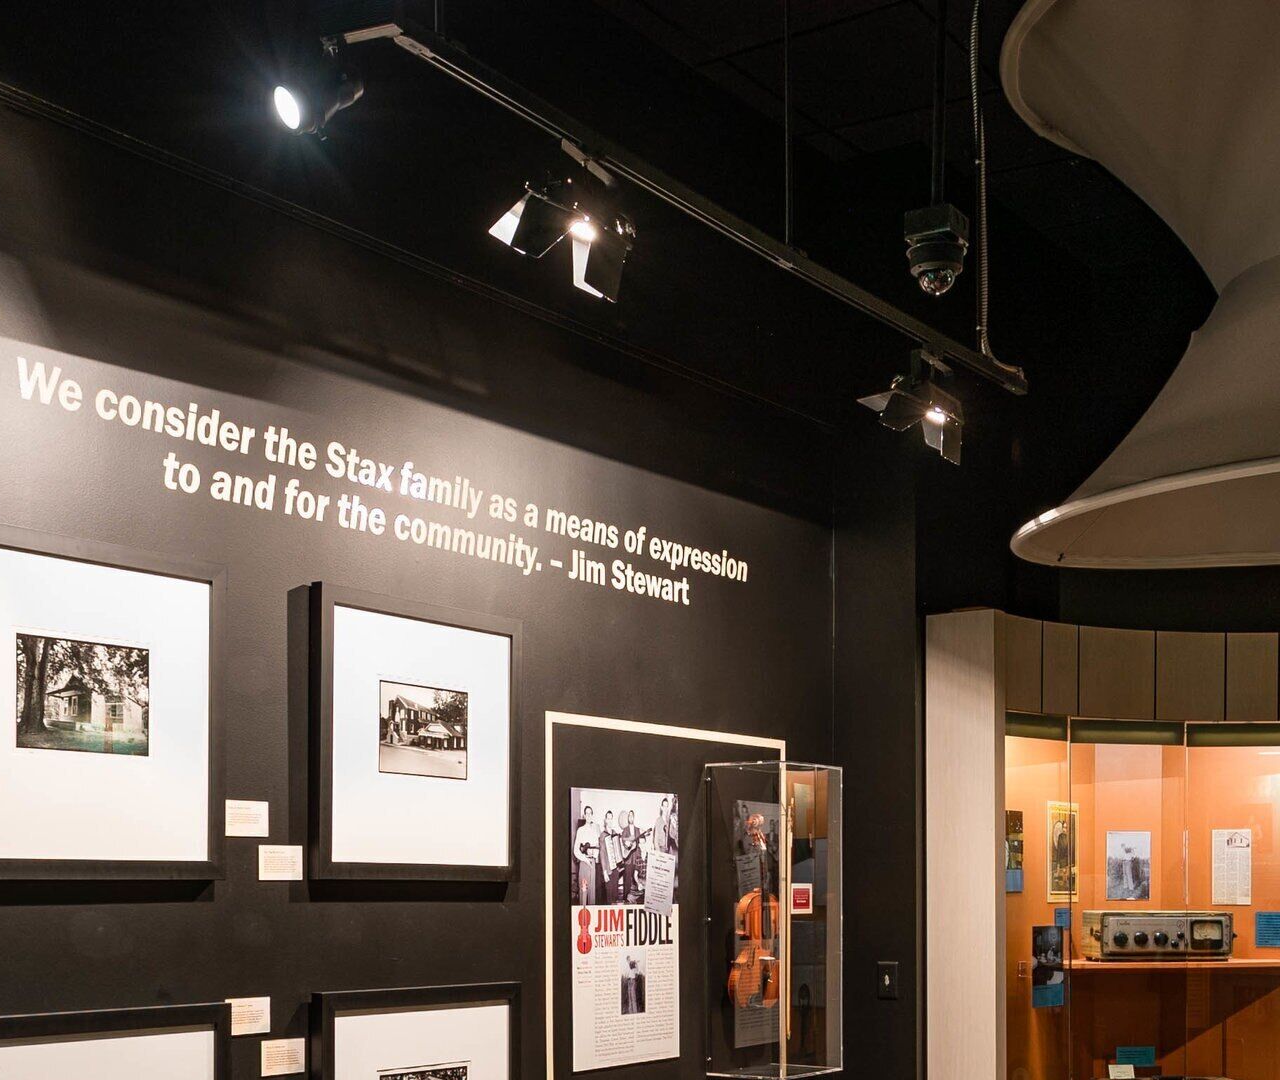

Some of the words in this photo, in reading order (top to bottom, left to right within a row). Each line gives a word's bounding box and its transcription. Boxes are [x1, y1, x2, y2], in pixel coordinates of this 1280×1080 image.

[17, 357, 83, 411] We
[94, 381, 256, 455] consider
[263, 425, 317, 470] the
[325, 441, 392, 491] Stax
[399, 461, 483, 518] family
[488, 489, 518, 523] as
[523, 502, 539, 528] a
[546, 507, 619, 548] means
[624, 524, 647, 555] of
[649, 534, 749, 583] expression
[162, 450, 201, 494] to
[210, 466, 275, 511] and
[283, 480, 330, 521] for
[337, 494, 386, 536] the
[393, 511, 542, 573] community.
[568, 548, 607, 584] Jim
[610, 560, 690, 605] Stewart
[595, 909, 624, 932] JIM
[625, 909, 673, 947] FIDDLE
[594, 934, 624, 948] STEWART'S
